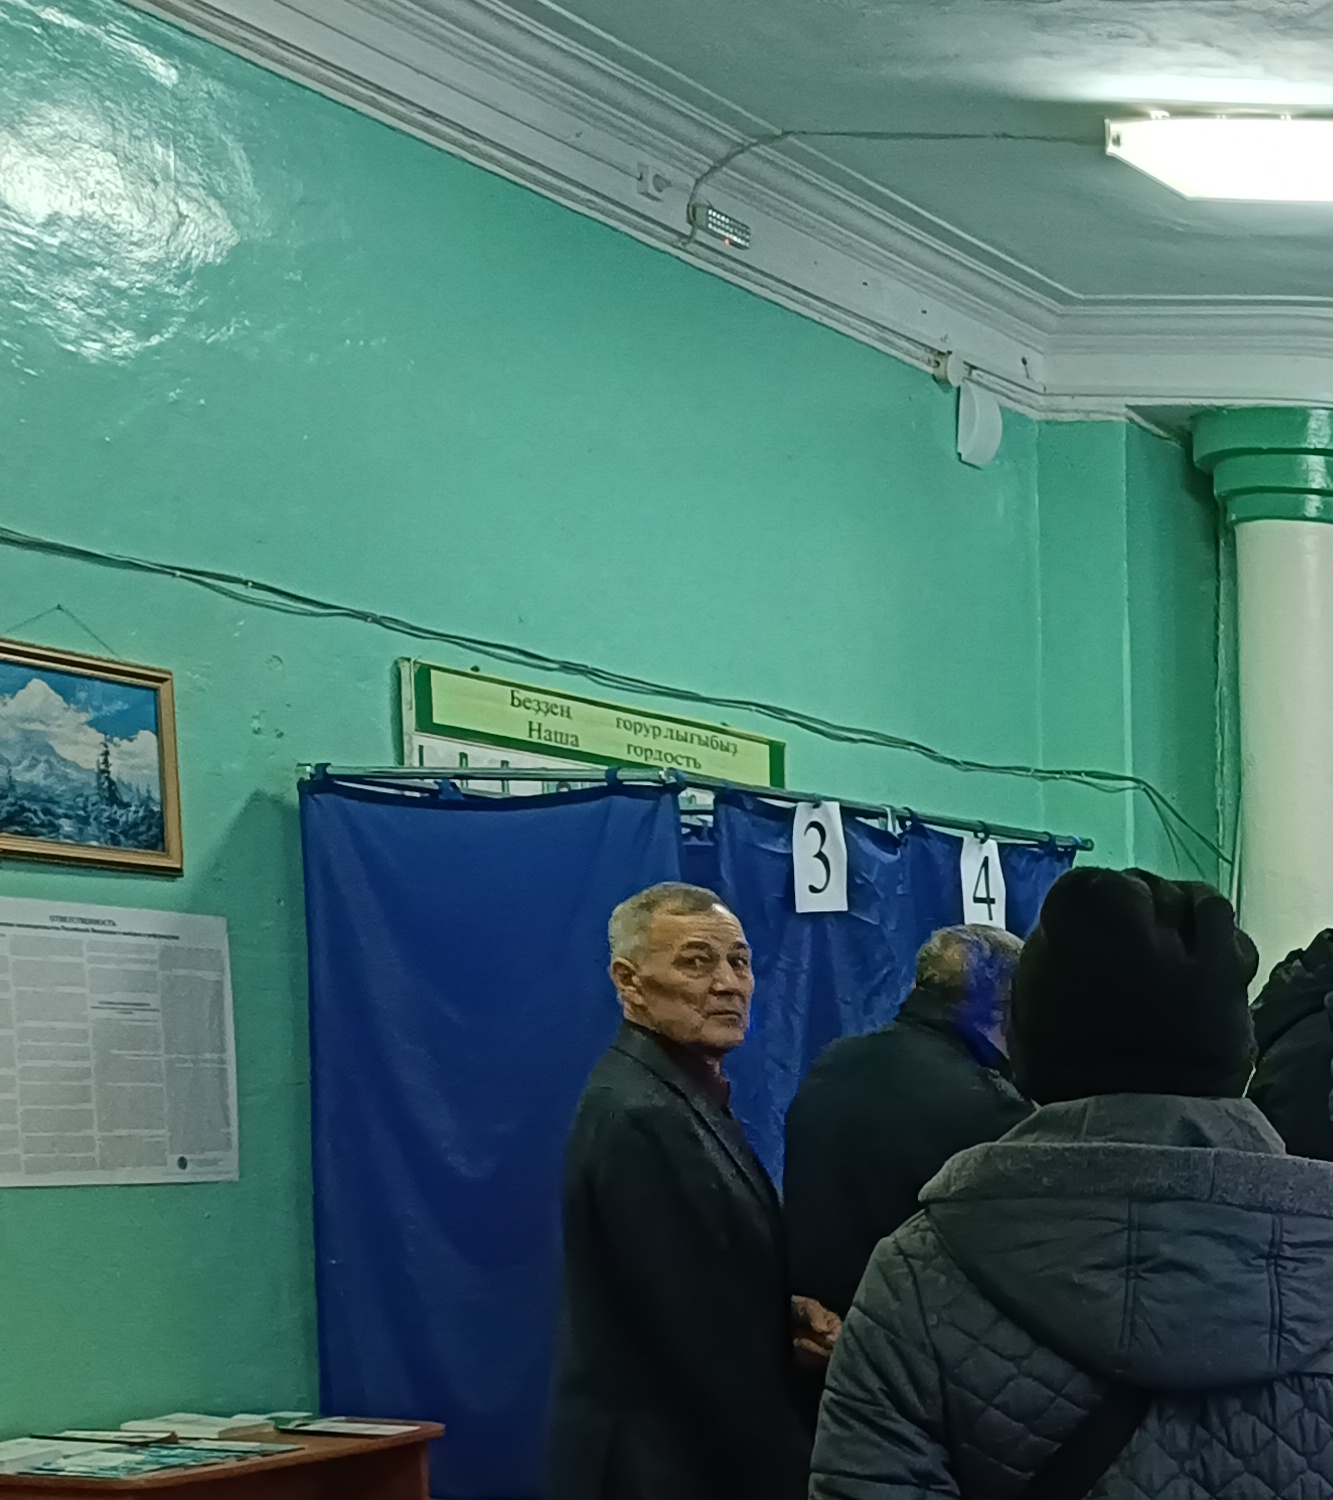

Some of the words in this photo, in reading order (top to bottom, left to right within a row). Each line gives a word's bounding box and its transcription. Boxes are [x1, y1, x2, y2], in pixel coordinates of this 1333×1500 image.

[527, 720, 580, 748] Наша
[626, 743, 702, 770] гордость
[804, 821, 831, 894] 3
[973, 856, 996, 921] 4
